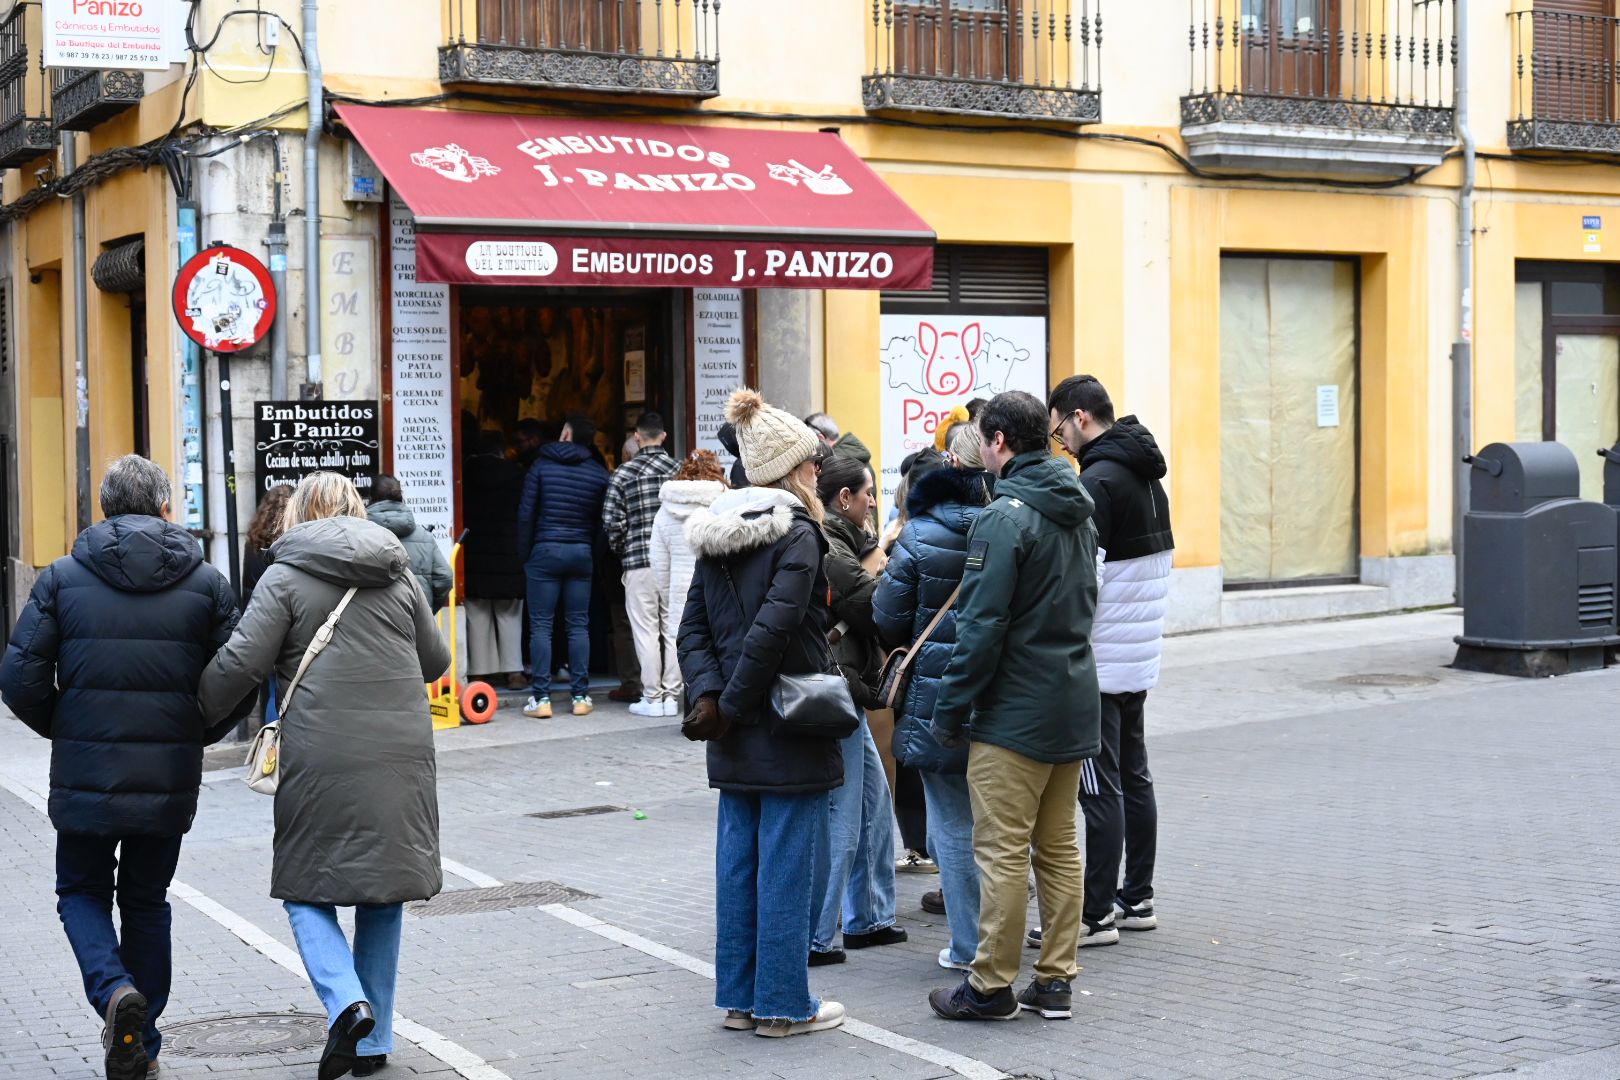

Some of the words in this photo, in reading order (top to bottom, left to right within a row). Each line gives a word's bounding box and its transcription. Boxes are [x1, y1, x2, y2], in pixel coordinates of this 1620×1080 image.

[73, 0, 143, 17] Panizo
[100, 24, 106, 32] y
[108, 22, 160, 33] Embutidos
[68, 40, 105, 49] Boutique
[122, 42, 160, 50] Embutido
[517, 135, 730, 168] EMBUTIDOS
[534, 164, 574, 187] J.
[576, 167, 756, 192] PANIZO
[480, 245, 491, 256] LA
[572, 248, 714, 275] EMBUTIDOS
[731, 250, 756, 282] J.
[764, 250, 894, 279] PANIZO
[394, 291, 445, 299] MORCILLAS
[397, 300, 442, 308] LEONESAS
[392, 327, 430, 336] QUESOS
[397, 354, 429, 363] QUESO
[400, 371, 413, 379] DE
[414, 371, 442, 379] MULO
[261, 405, 373, 420] Embutidos
[270, 422, 287, 441] J.
[293, 422, 364, 437] Panizo
[265, 452, 290, 469] Cecina
[291, 452, 300, 468] de
[301, 455, 319, 470] vaca,
[320, 451, 344, 467] caballo
[345, 455, 350, 471] y
[351, 450, 371, 466] chivo
[353, 472, 372, 487] chivo
[402, 496, 436, 504] ARIEDAD
